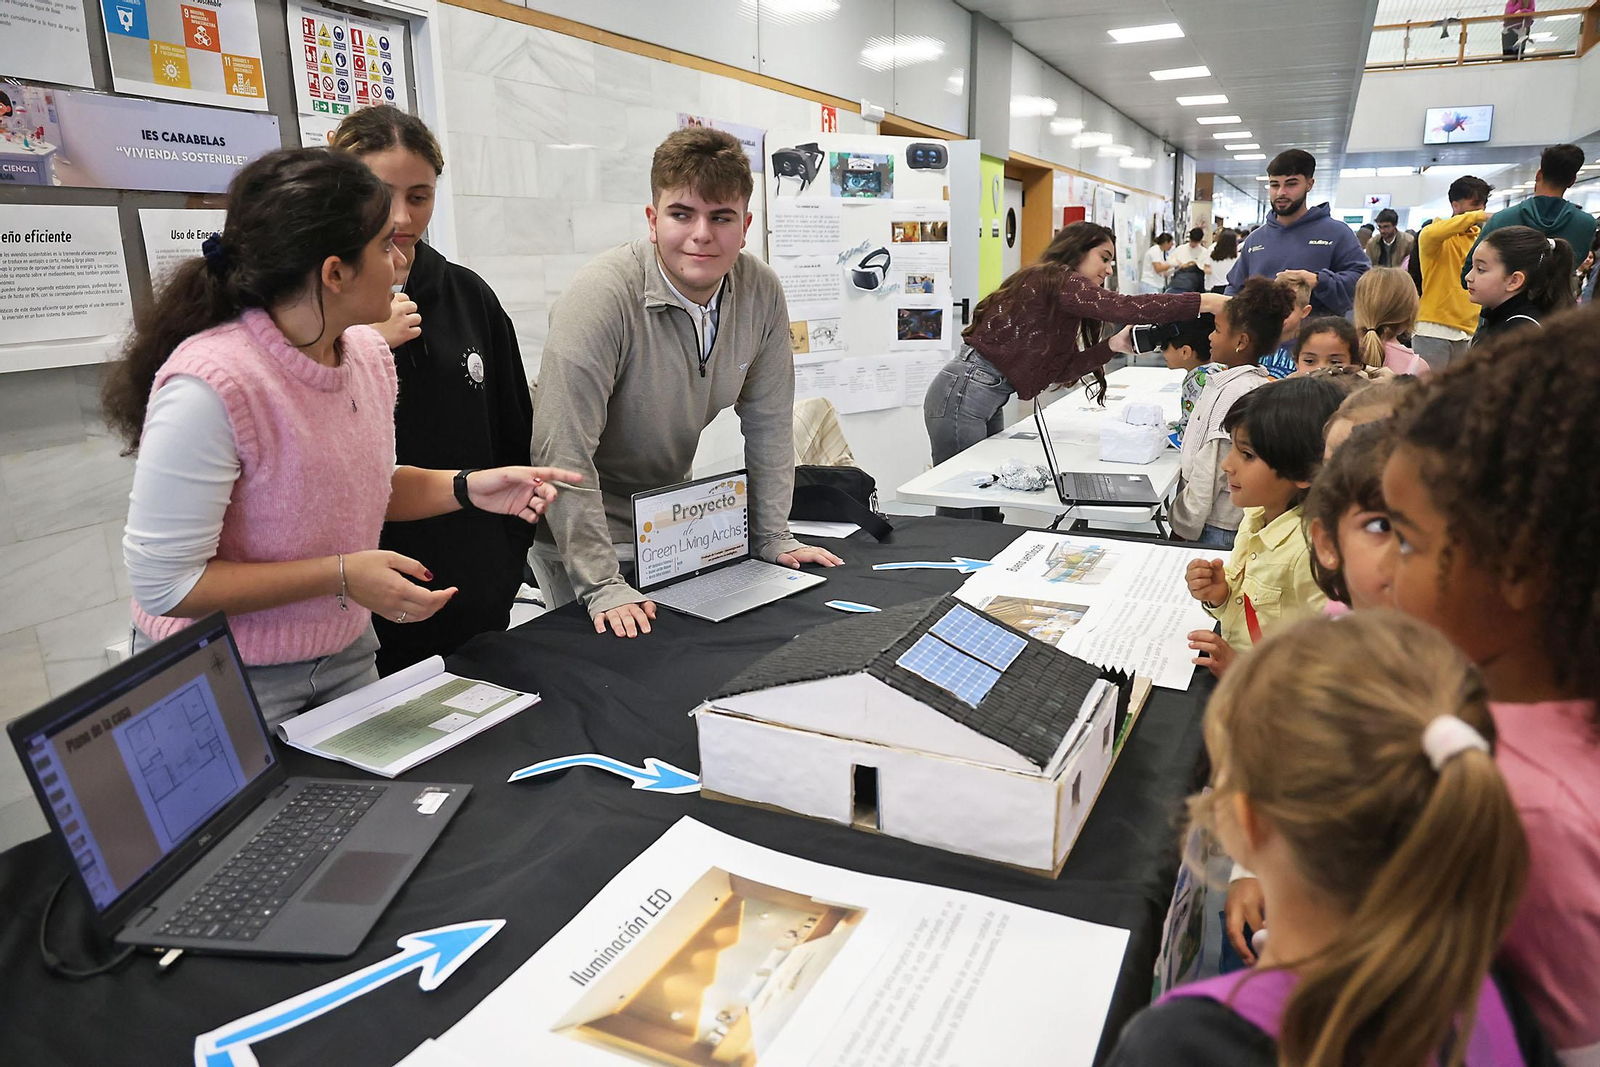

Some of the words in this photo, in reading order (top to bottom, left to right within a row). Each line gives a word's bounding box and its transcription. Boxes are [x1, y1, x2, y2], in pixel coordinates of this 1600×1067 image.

[184, 8, 189, 18] 9
[153, 43, 158, 54] 7
[224, 56, 231, 66] 11
[142, 130, 158, 141] IES
[161, 132, 226, 147] CARABELAS
[2, 164, 36, 174] CIENCIA
[1, 231, 21, 243] eño
[25, 230, 72, 242] eficiente
[171, 230, 184, 240] Uso
[187, 229, 194, 239] de
[672, 494, 736, 522] Proyecto
[683, 518, 698, 536] de
[642, 544, 677, 562] Green
[679, 534, 709, 552] Living
[711, 525, 742, 543] Archs
[65, 731, 91, 754] Plano
[91, 724, 103, 738] de
[111, 706, 132, 725] casa
[569, 917, 648, 986] Iluminación
[640, 888, 672, 918] LED
